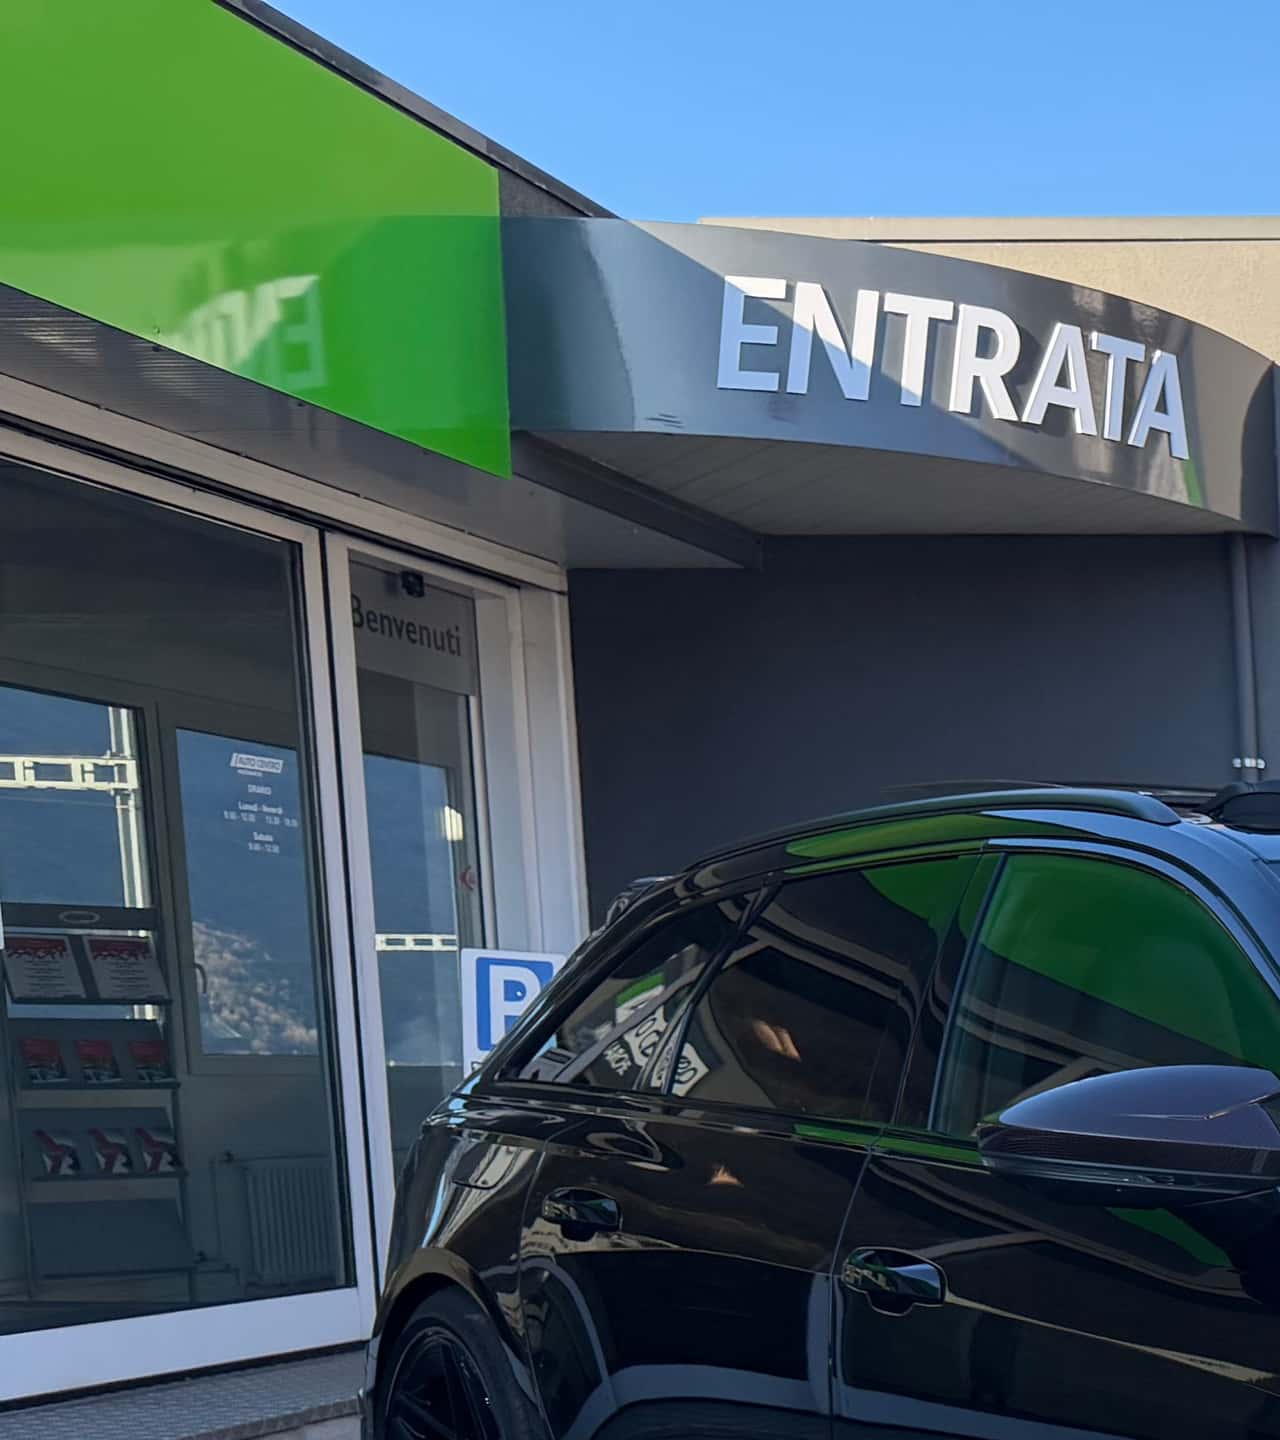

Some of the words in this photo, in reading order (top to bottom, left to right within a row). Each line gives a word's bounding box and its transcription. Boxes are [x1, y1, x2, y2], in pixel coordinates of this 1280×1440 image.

[717, 275, 1190, 461] ENTRATA
[351, 593, 462, 657] Benvenuti
[489, 964, 542, 1046] P
